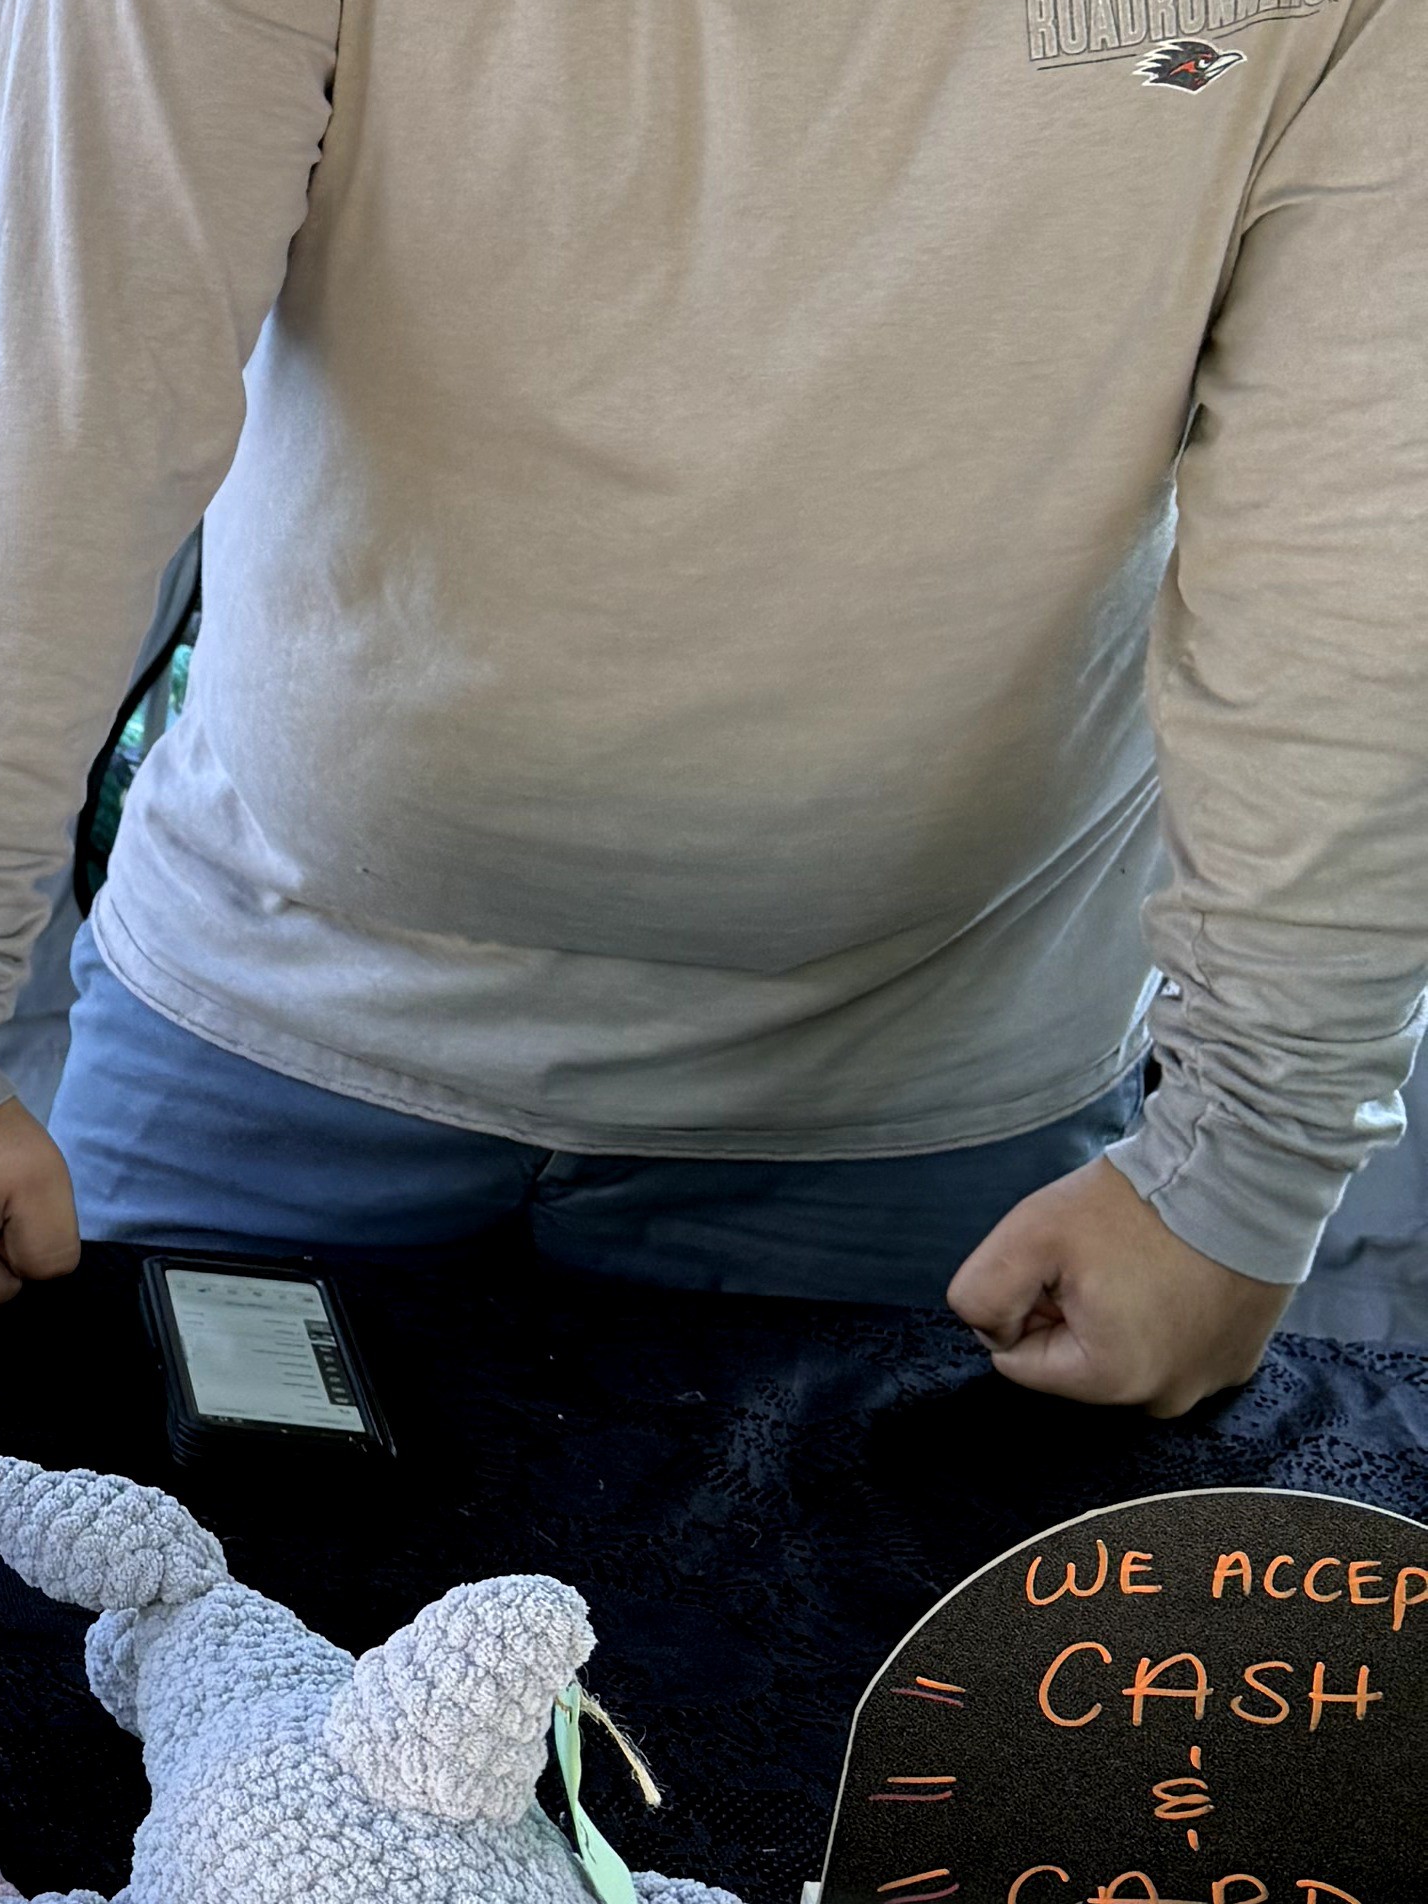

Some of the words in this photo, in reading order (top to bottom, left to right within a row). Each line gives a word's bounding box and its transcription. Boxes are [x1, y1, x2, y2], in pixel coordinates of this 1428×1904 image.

[1025, 1539, 1162, 1606] WE
[1211, 1551, 1428, 1631] ACCEP
[1038, 1642, 1382, 1731] CASH
